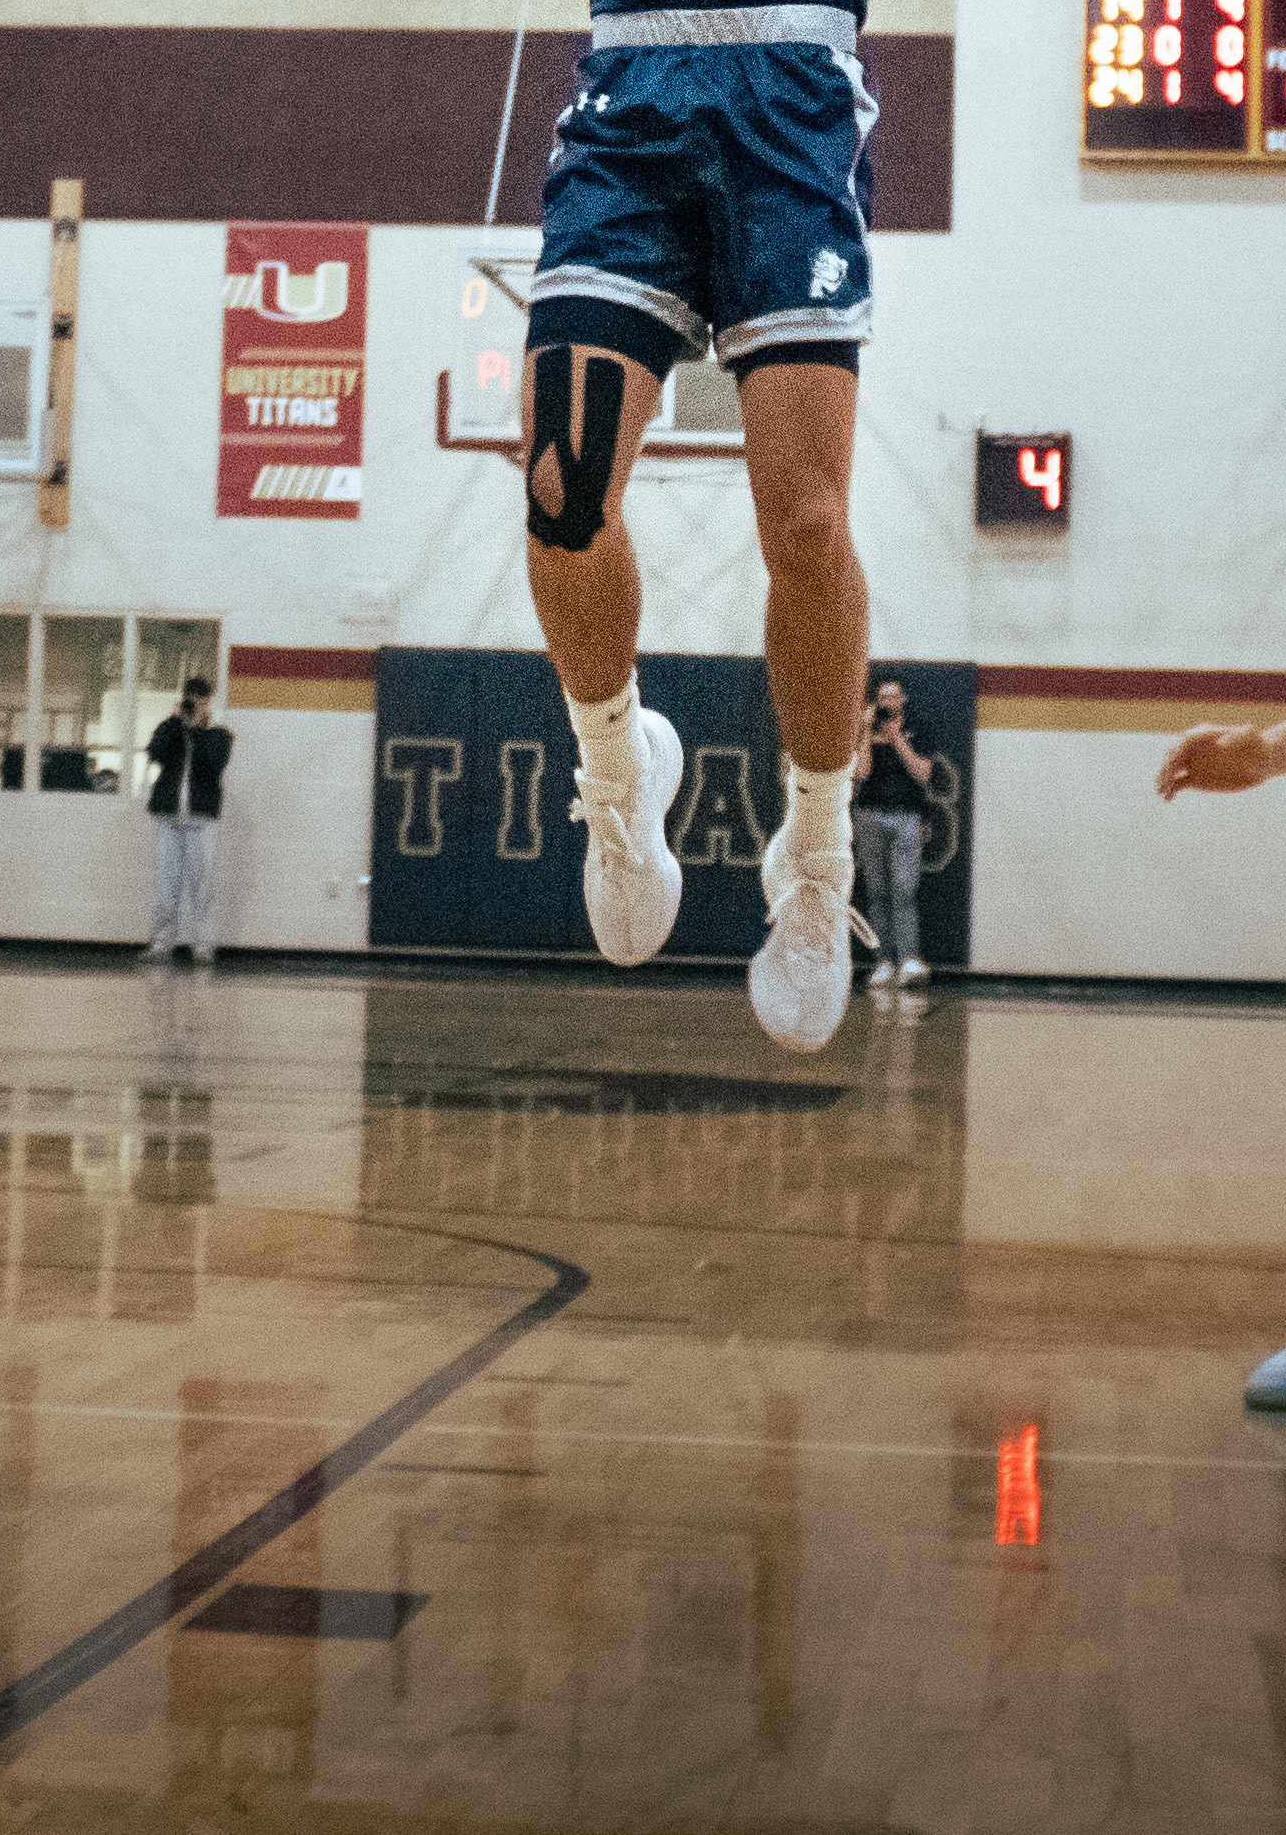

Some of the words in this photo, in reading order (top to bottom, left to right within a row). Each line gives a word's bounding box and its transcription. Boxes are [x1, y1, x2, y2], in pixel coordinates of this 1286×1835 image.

[1150, 23, 1183, 67] 0
[1213, 23, 1245, 67] 0
[1163, 68, 1182, 105] 1
[226, 365, 359, 397] UNIVERSITY
[247, 396, 339, 427] TITANS
[1017, 447, 1062, 510] 4
